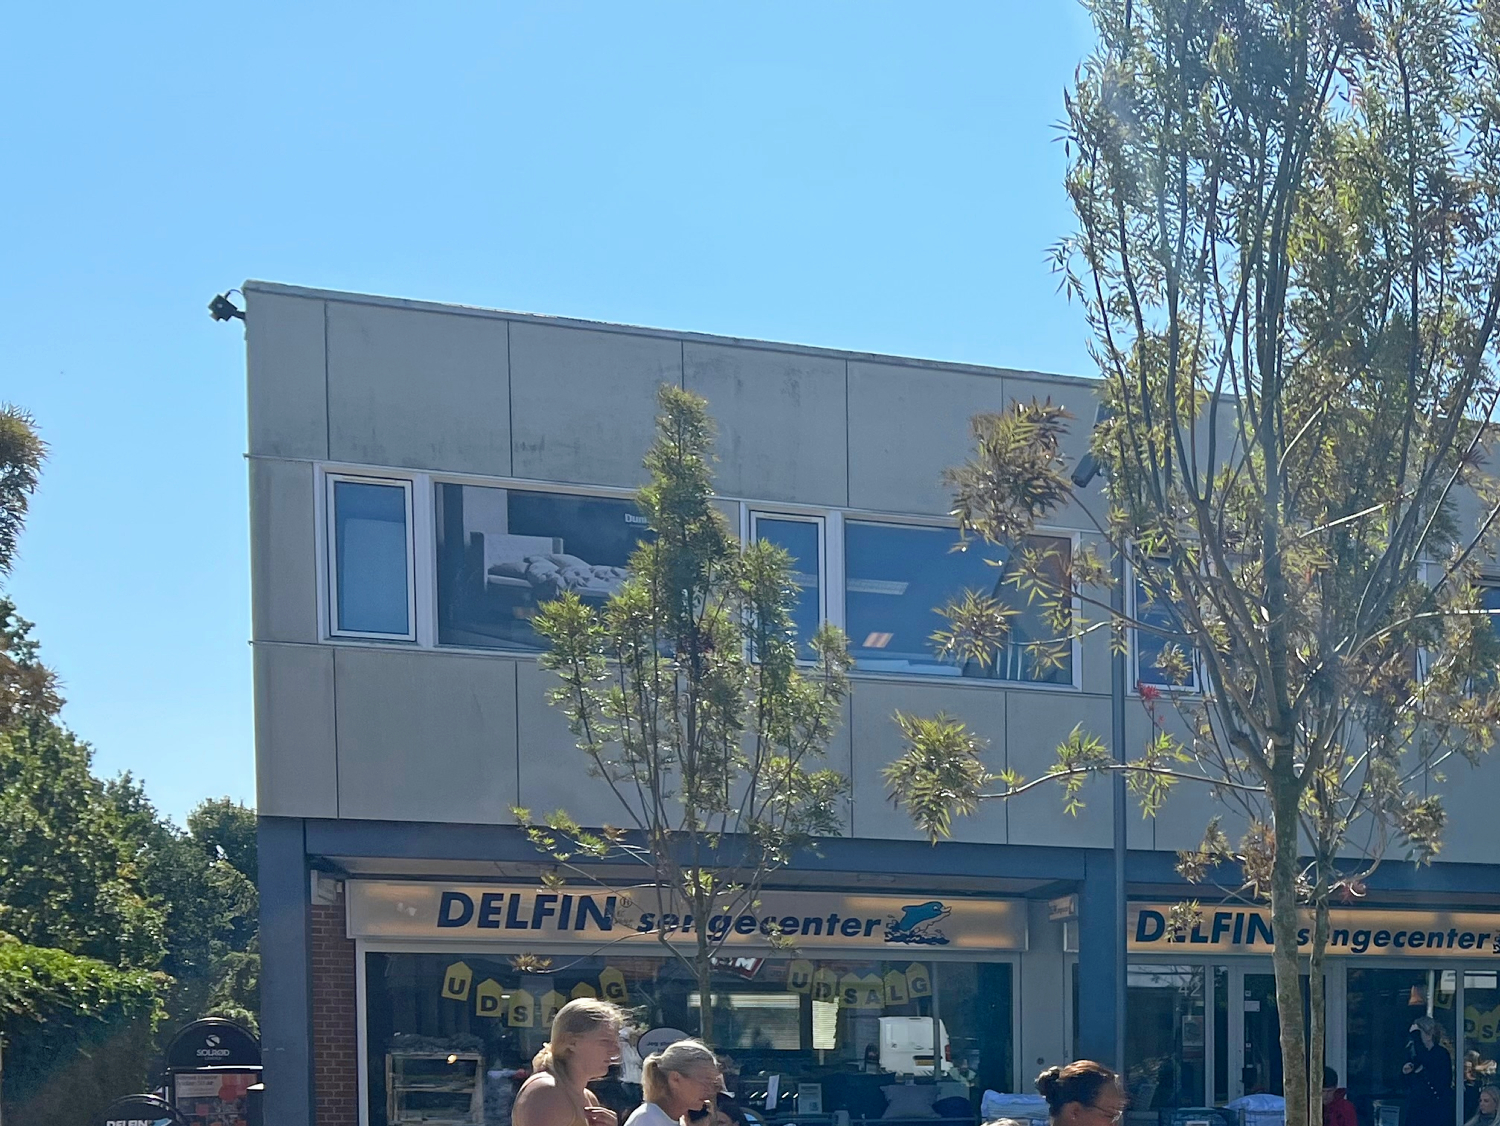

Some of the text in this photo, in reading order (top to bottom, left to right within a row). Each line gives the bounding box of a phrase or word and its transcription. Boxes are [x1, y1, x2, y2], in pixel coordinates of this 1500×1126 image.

[437, 891, 617, 931] DELFIN
[1296, 928, 1491, 954] sngecenter
[447, 976, 625, 1024] UDSG
[791, 971, 928, 1005] UDSALG
[1178, 981, 1202, 997] 42
